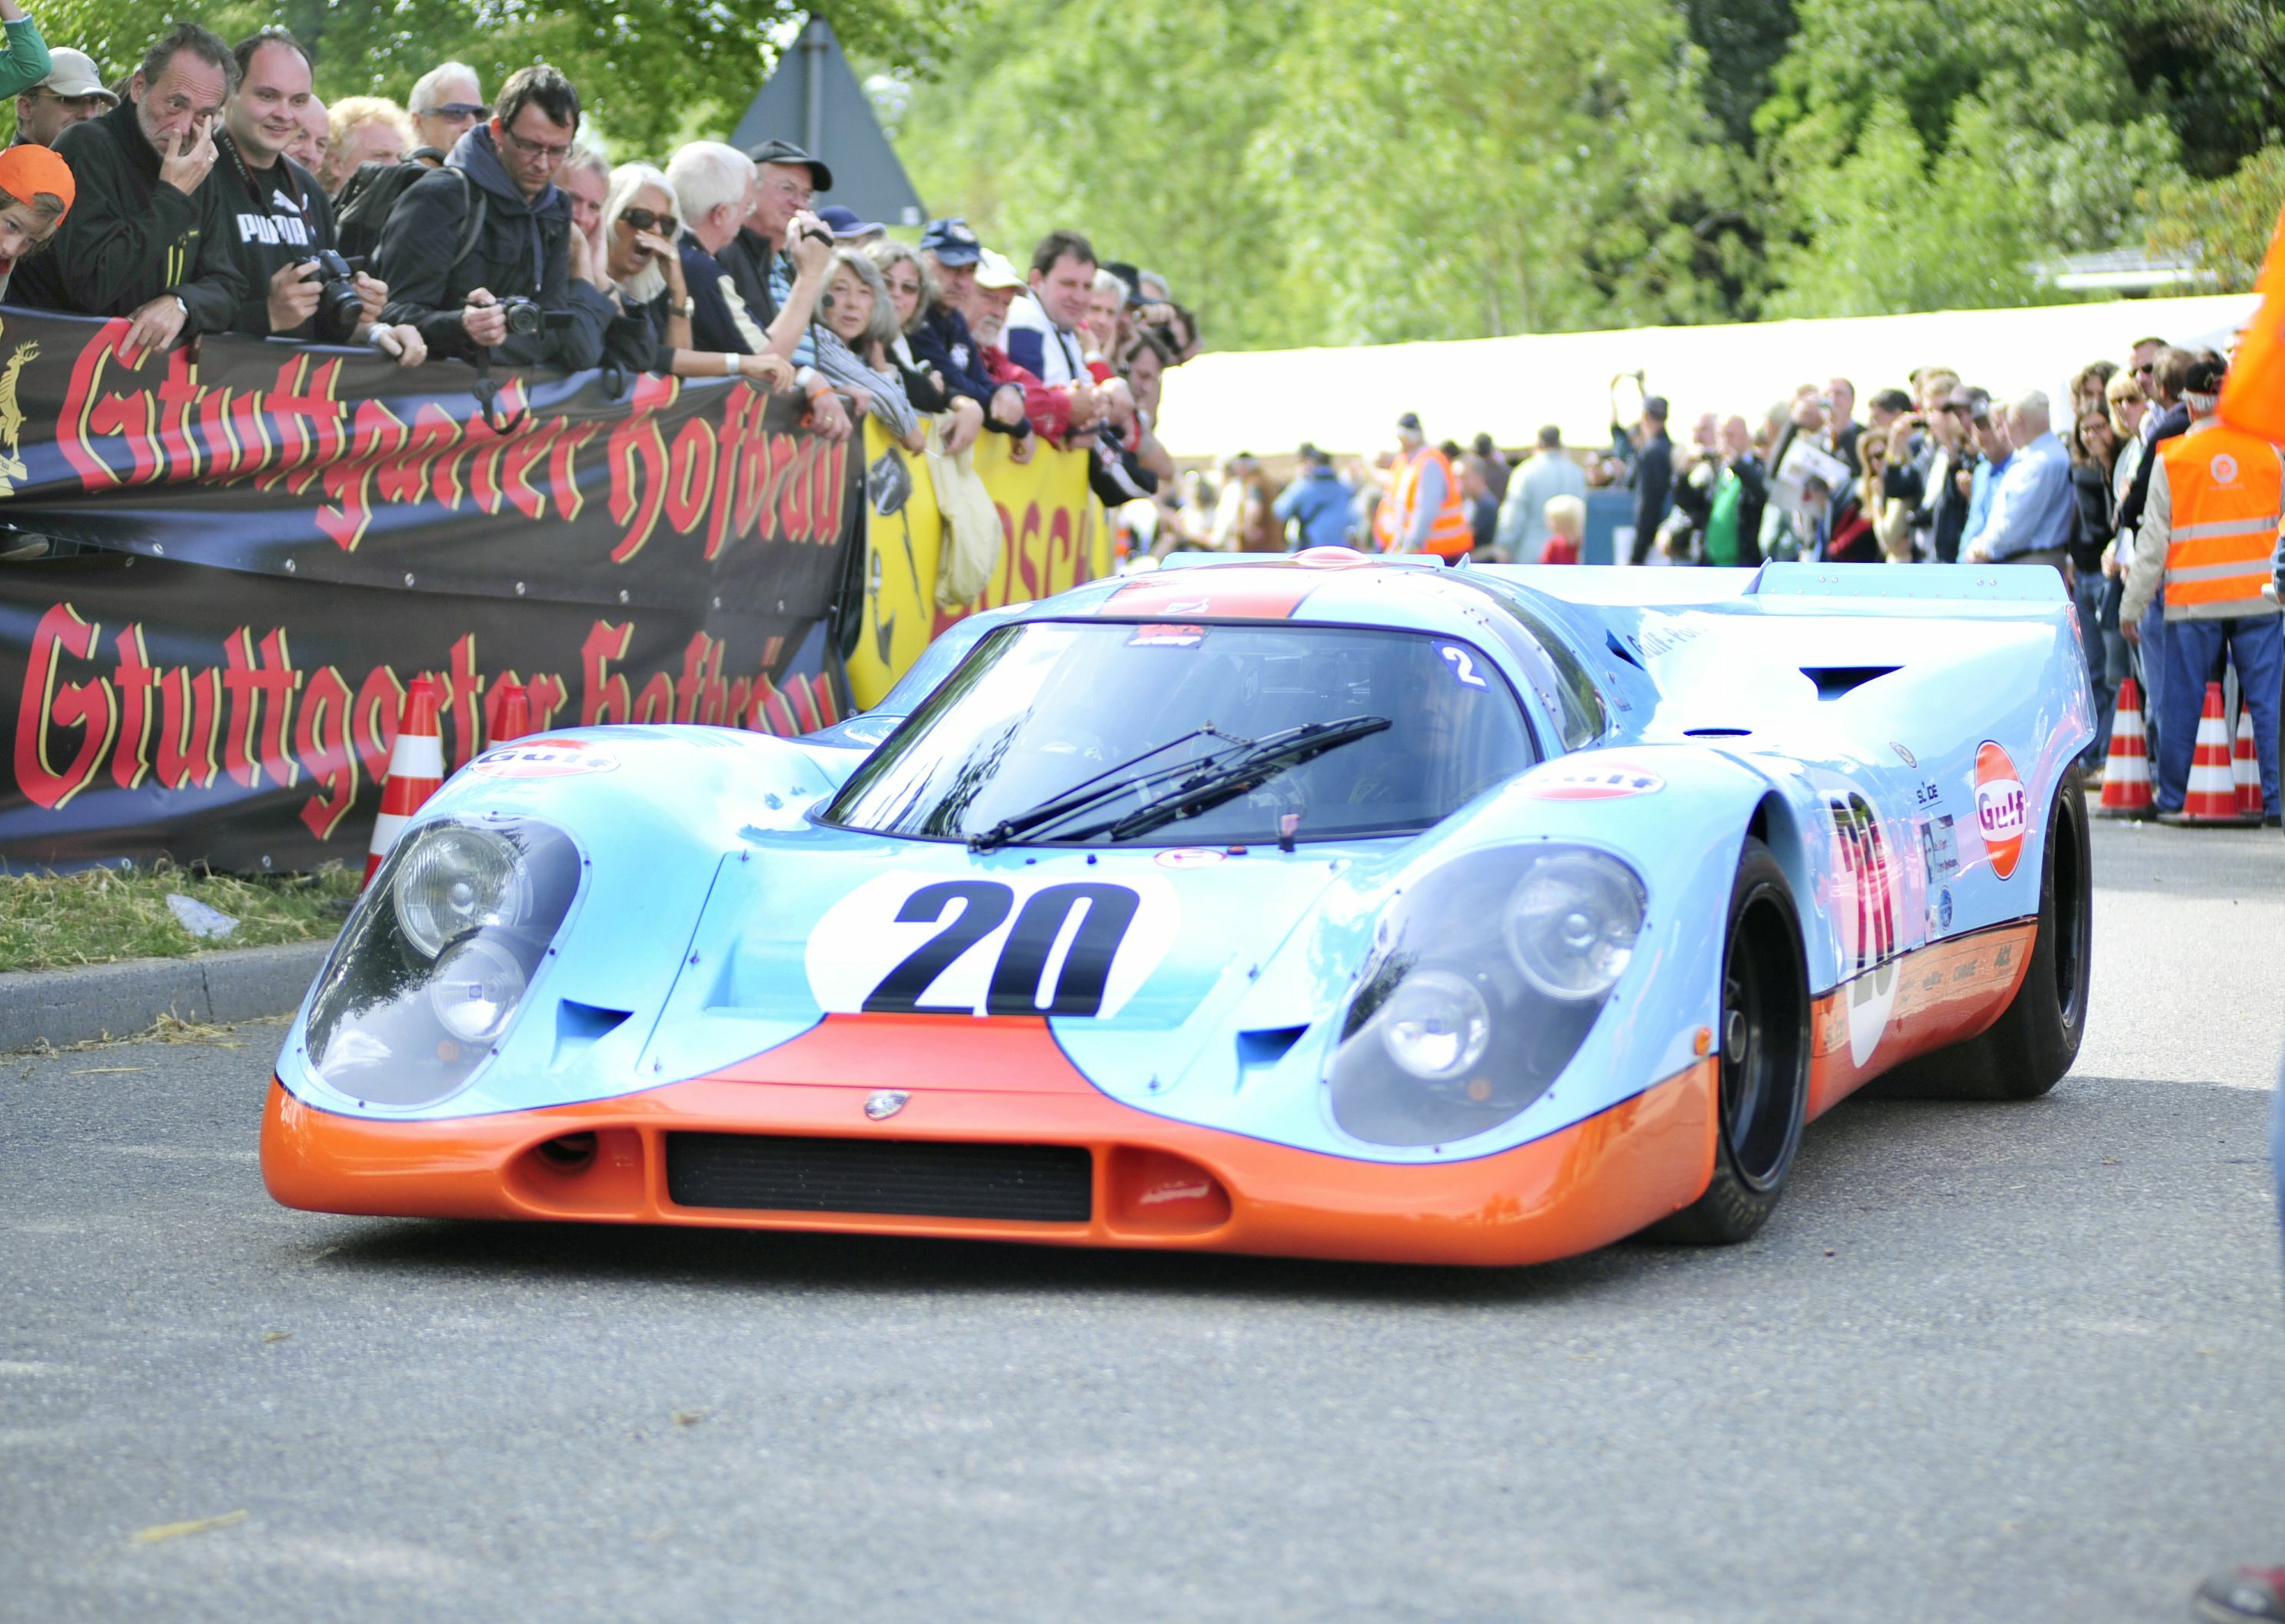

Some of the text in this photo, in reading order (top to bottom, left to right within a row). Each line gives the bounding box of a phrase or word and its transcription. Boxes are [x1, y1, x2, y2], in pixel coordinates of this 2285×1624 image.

[1442, 646, 1487, 687] 2
[1978, 790, 2025, 831] Gulf
[861, 879, 1141, 1017] 20
